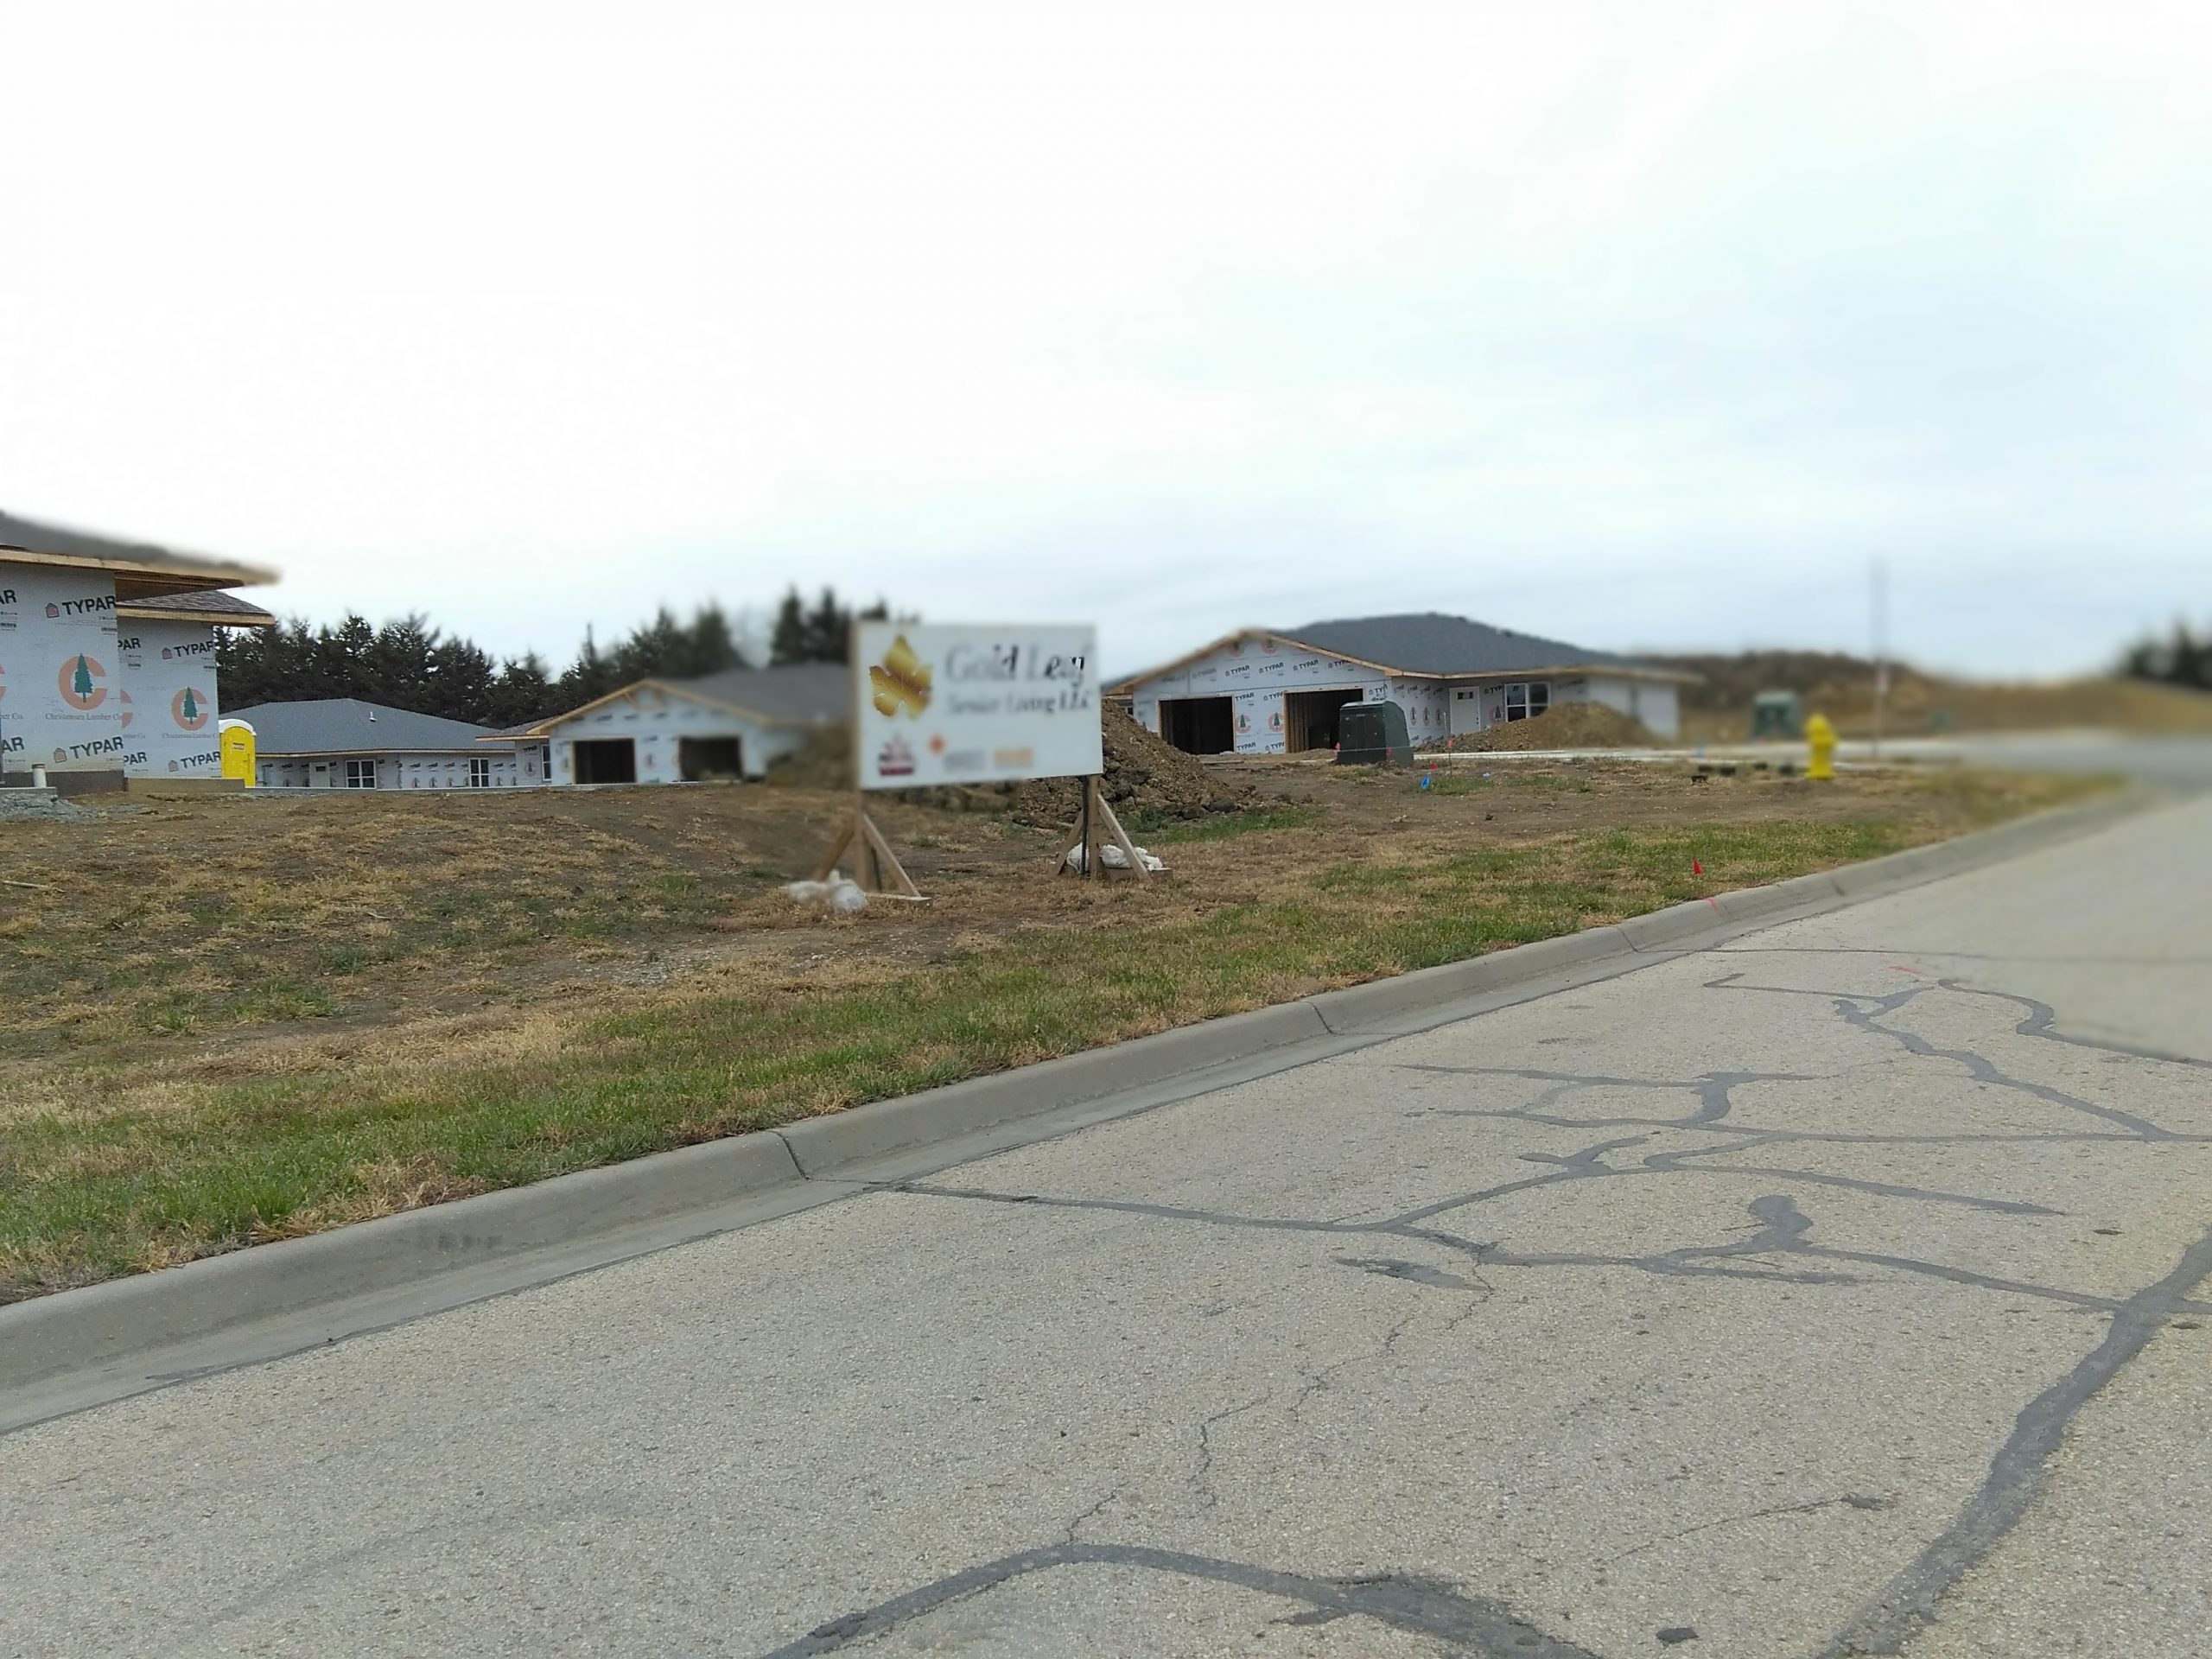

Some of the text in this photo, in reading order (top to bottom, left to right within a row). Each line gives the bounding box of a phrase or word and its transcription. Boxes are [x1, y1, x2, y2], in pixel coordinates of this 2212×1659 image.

[61, 595, 117, 615] TYPAR
[1230, 664, 1250, 674] TYPAR
[1265, 662, 1284, 672] TYPAR
[1299, 659, 1319, 670] TYPAR
[1235, 692, 1255, 702] TYPAR
[69, 736, 124, 759] TYPAR
[1236, 741, 1256, 751] TYPAR
[181, 751, 220, 768] TYPAR
